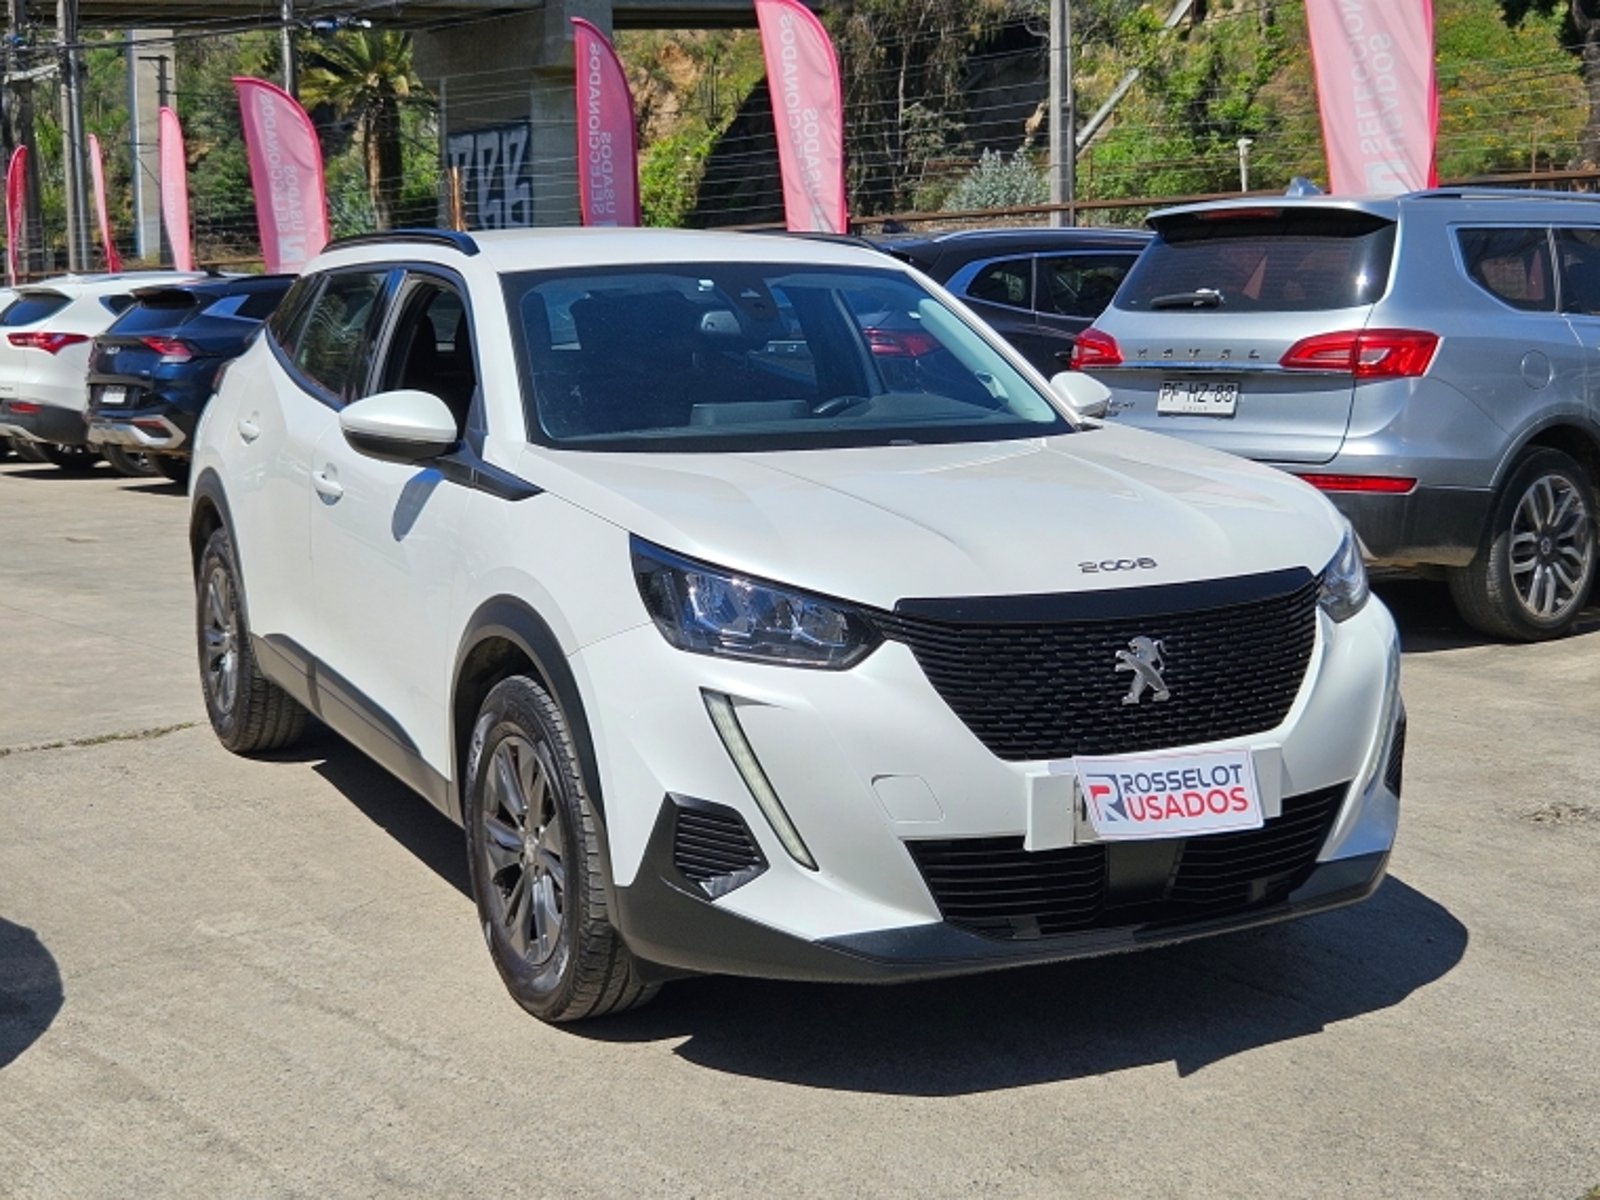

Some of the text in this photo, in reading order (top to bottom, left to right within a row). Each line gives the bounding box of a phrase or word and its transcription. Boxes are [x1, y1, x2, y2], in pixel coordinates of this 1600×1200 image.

[1077, 557, 1158, 573] 2008
[1120, 764, 1242, 794] ROSSELOT
[1126, 787, 1248, 821] USADOS
